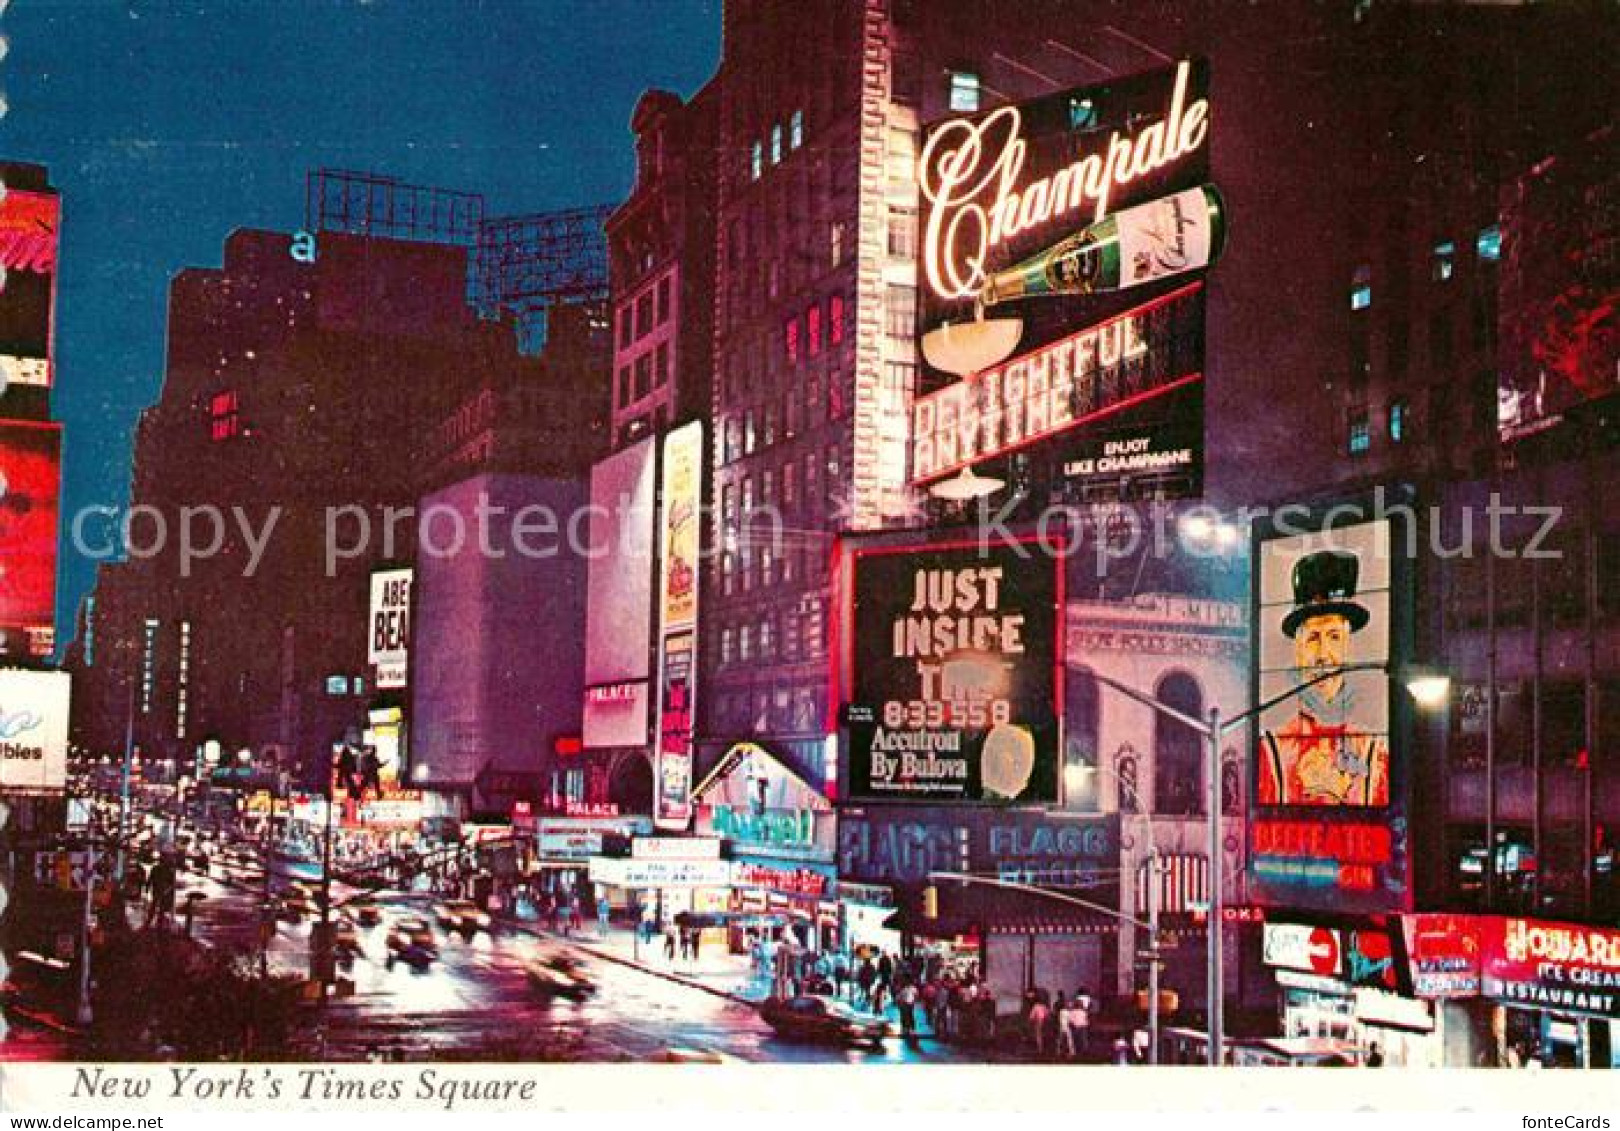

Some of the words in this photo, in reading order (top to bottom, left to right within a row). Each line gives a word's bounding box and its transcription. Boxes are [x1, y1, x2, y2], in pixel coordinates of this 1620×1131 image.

[919, 59, 1209, 298] Champale
[910, 565, 1003, 613] JUST
[0, 742, 43, 760] bles
[870, 725, 961, 751] Accutron
[870, 751, 899, 779] By
[900, 751, 969, 779] Bulova
